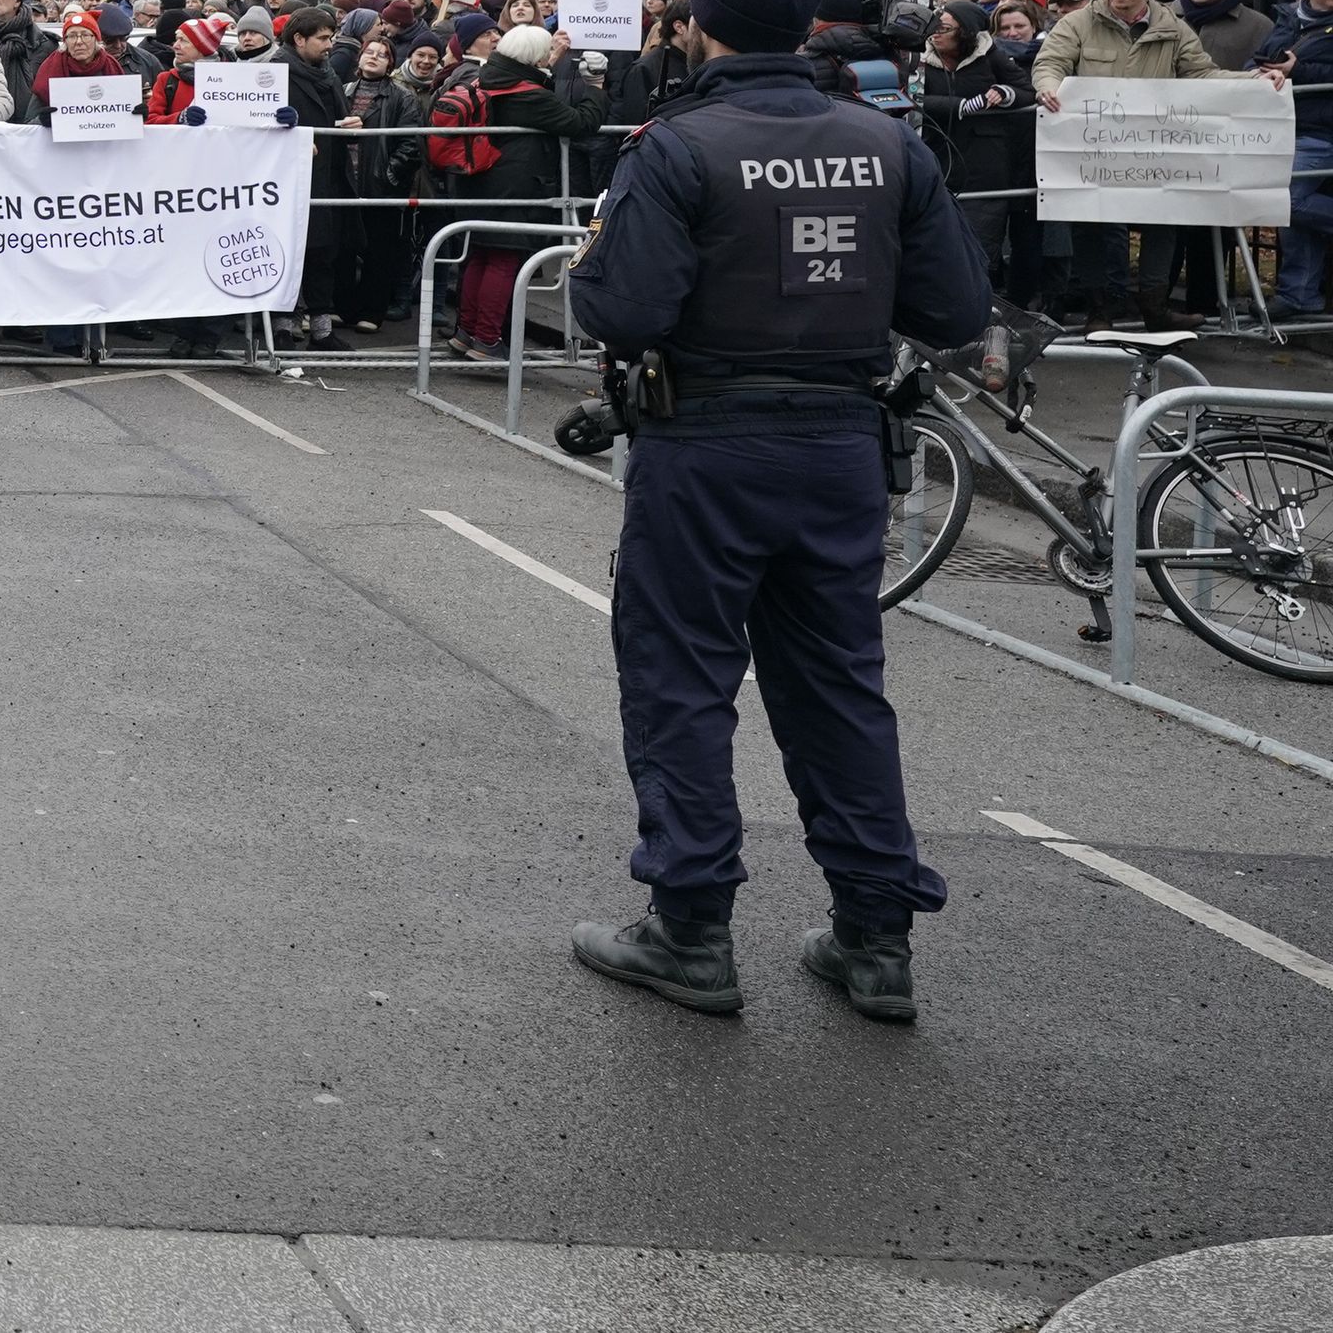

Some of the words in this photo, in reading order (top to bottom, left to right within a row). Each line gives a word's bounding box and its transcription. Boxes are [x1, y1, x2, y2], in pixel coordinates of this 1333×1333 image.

[569, 16, 633, 24] DEMOKRATIE
[206, 75, 223, 84] Aus
[203, 91, 281, 102] GESCHICHTE
[61, 103, 131, 116] DEMOKRATIE
[249, 110, 277, 118] lernen
[1083, 92, 1126, 126] FPÖ
[78, 121, 116, 130] schützen
[740, 156, 885, 190] POLIZEI
[33, 192, 144, 220] GEGEN
[154, 181, 280, 215] RECHTS
[218, 225, 265, 250] OMAS
[793, 216, 857, 252] BE
[220, 244, 271, 268] GEGEN
[221, 262, 279, 287] RECHTS
[807, 258, 843, 282] 24
